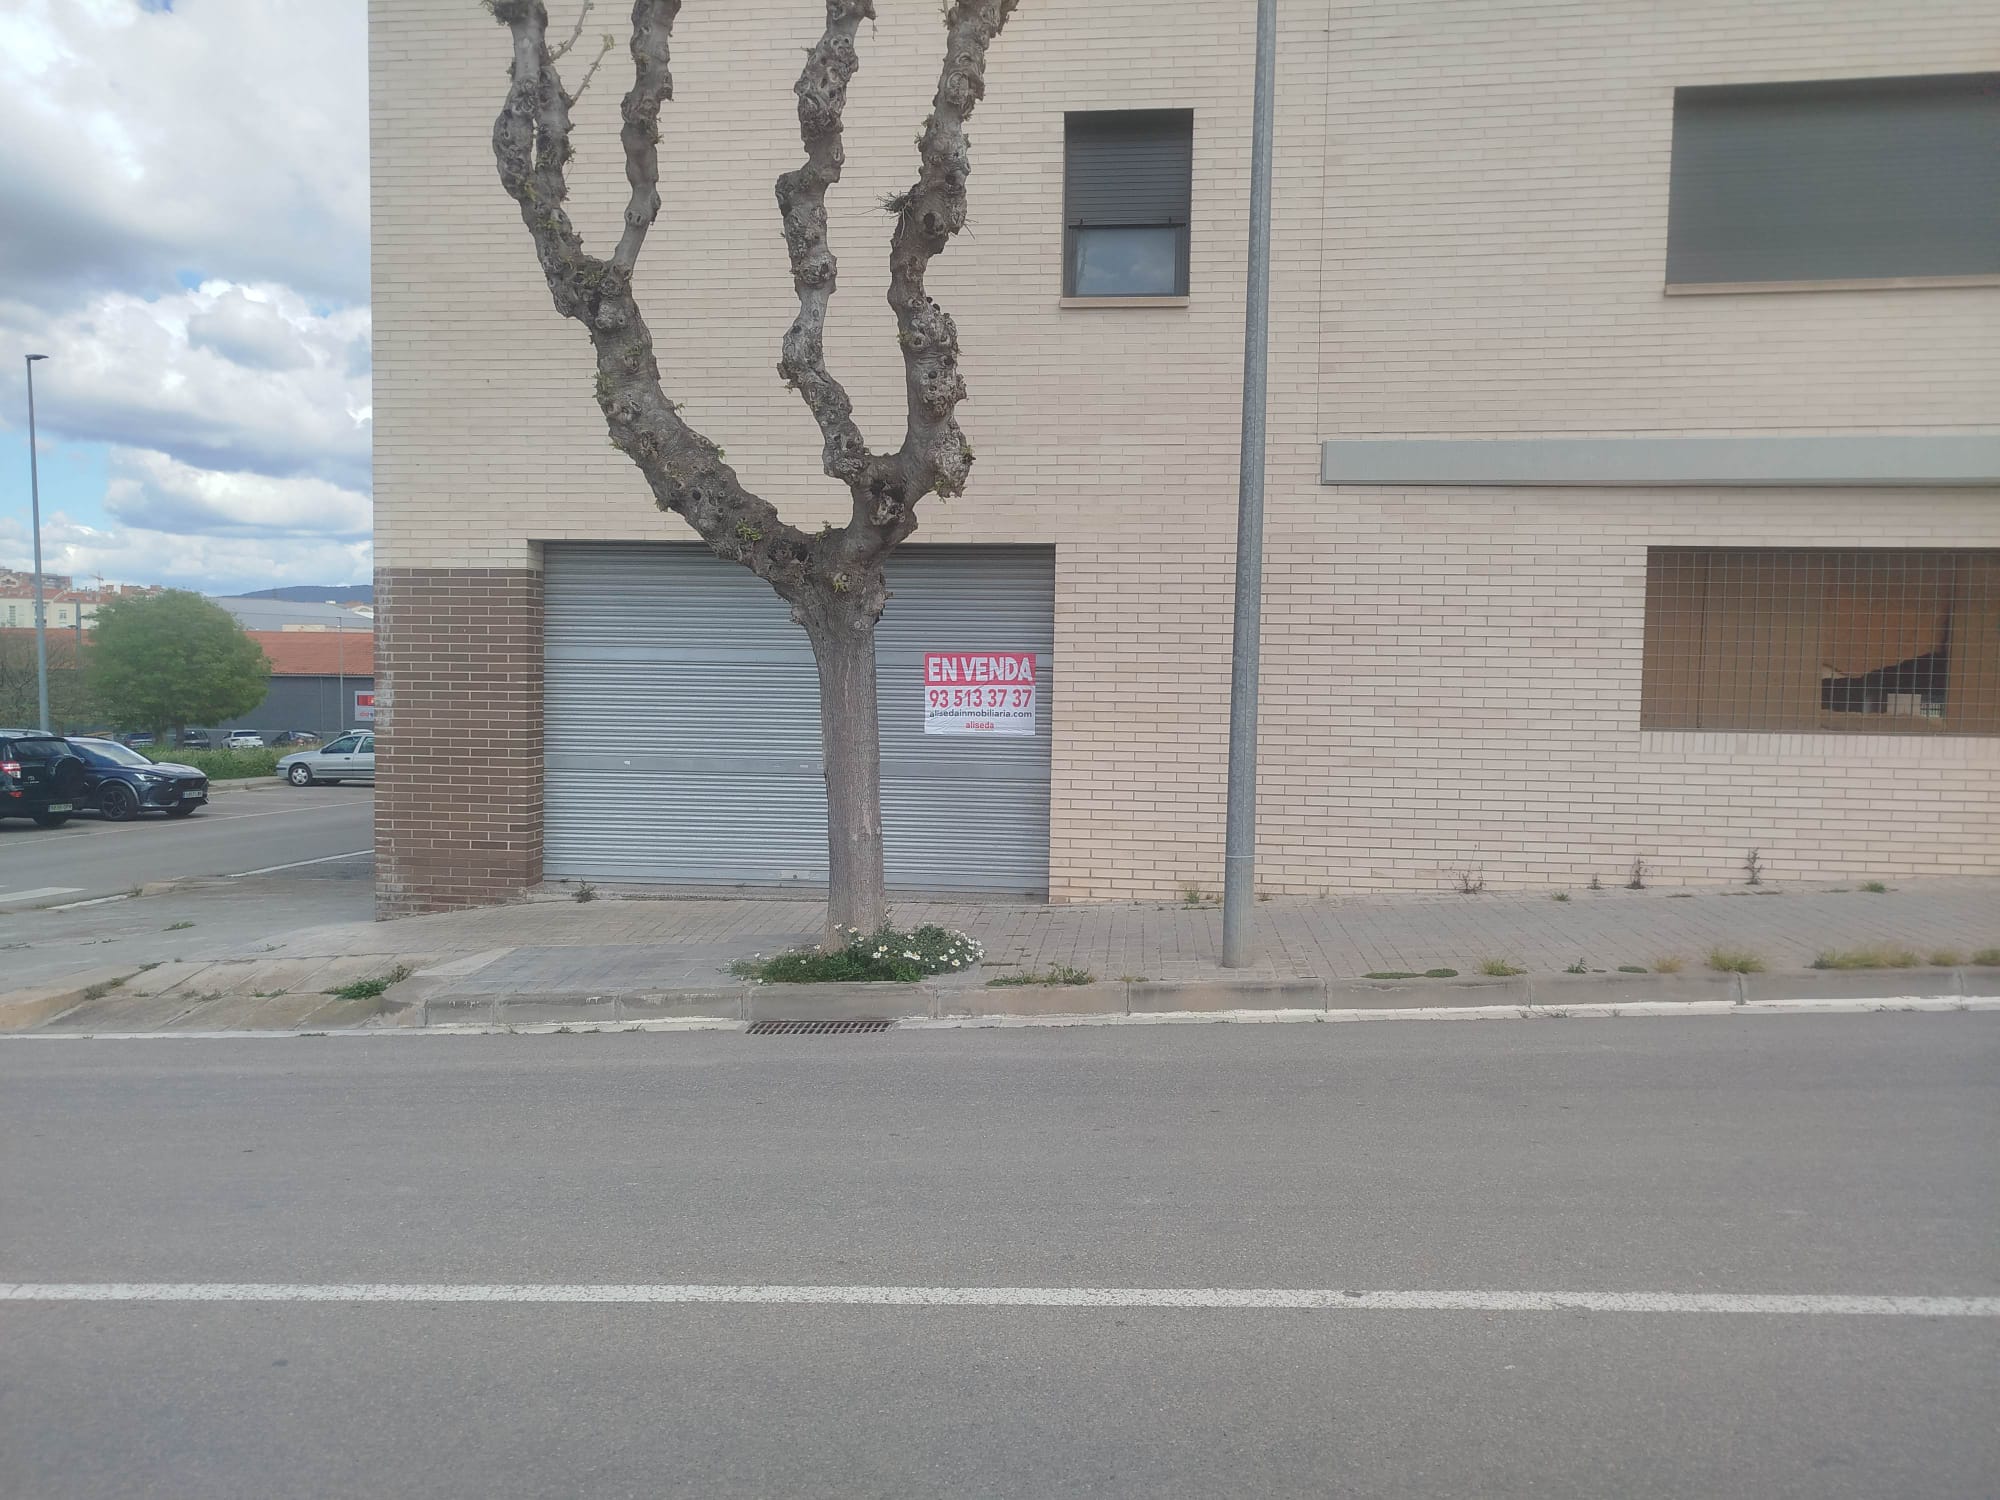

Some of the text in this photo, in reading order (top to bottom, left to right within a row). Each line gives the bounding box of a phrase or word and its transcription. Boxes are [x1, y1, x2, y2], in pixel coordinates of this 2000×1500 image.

[928, 656, 1033, 682] EN VENDA
[929, 688, 1033, 708] 93 513 37 37
[929, 709, 1032, 718] alisedainmobiliaria.com
[965, 720, 995, 729] aliseda
